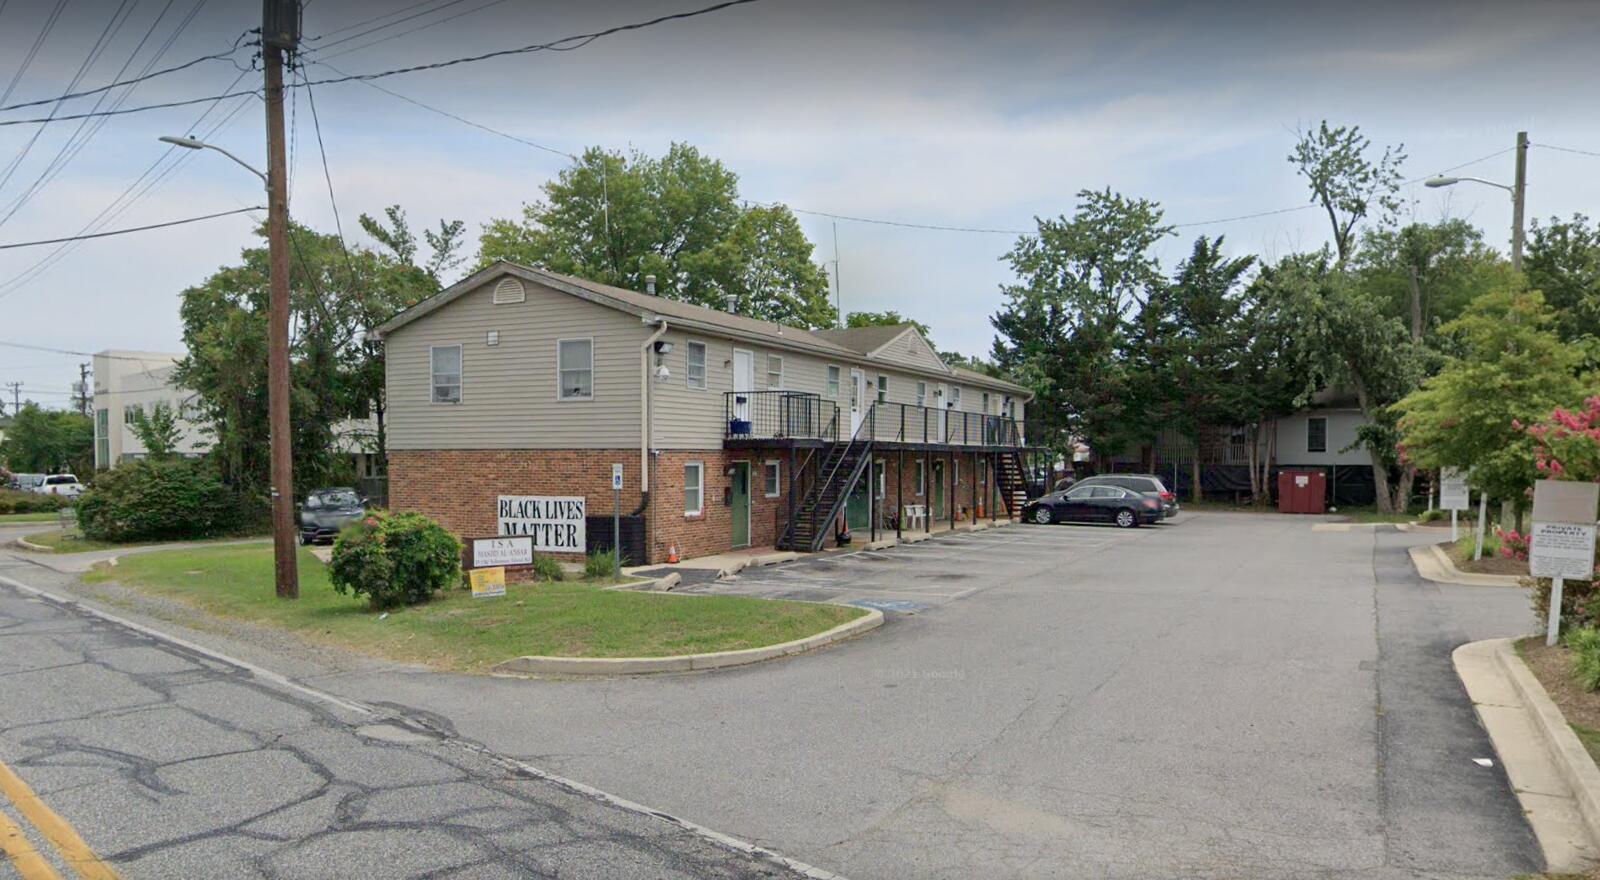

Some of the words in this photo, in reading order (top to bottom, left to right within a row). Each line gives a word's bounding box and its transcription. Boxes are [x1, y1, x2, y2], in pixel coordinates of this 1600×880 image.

[500, 500, 541, 519] BLACK
[545, 500, 583, 519] LIVES
[504, 522, 578, 547] MATTER
